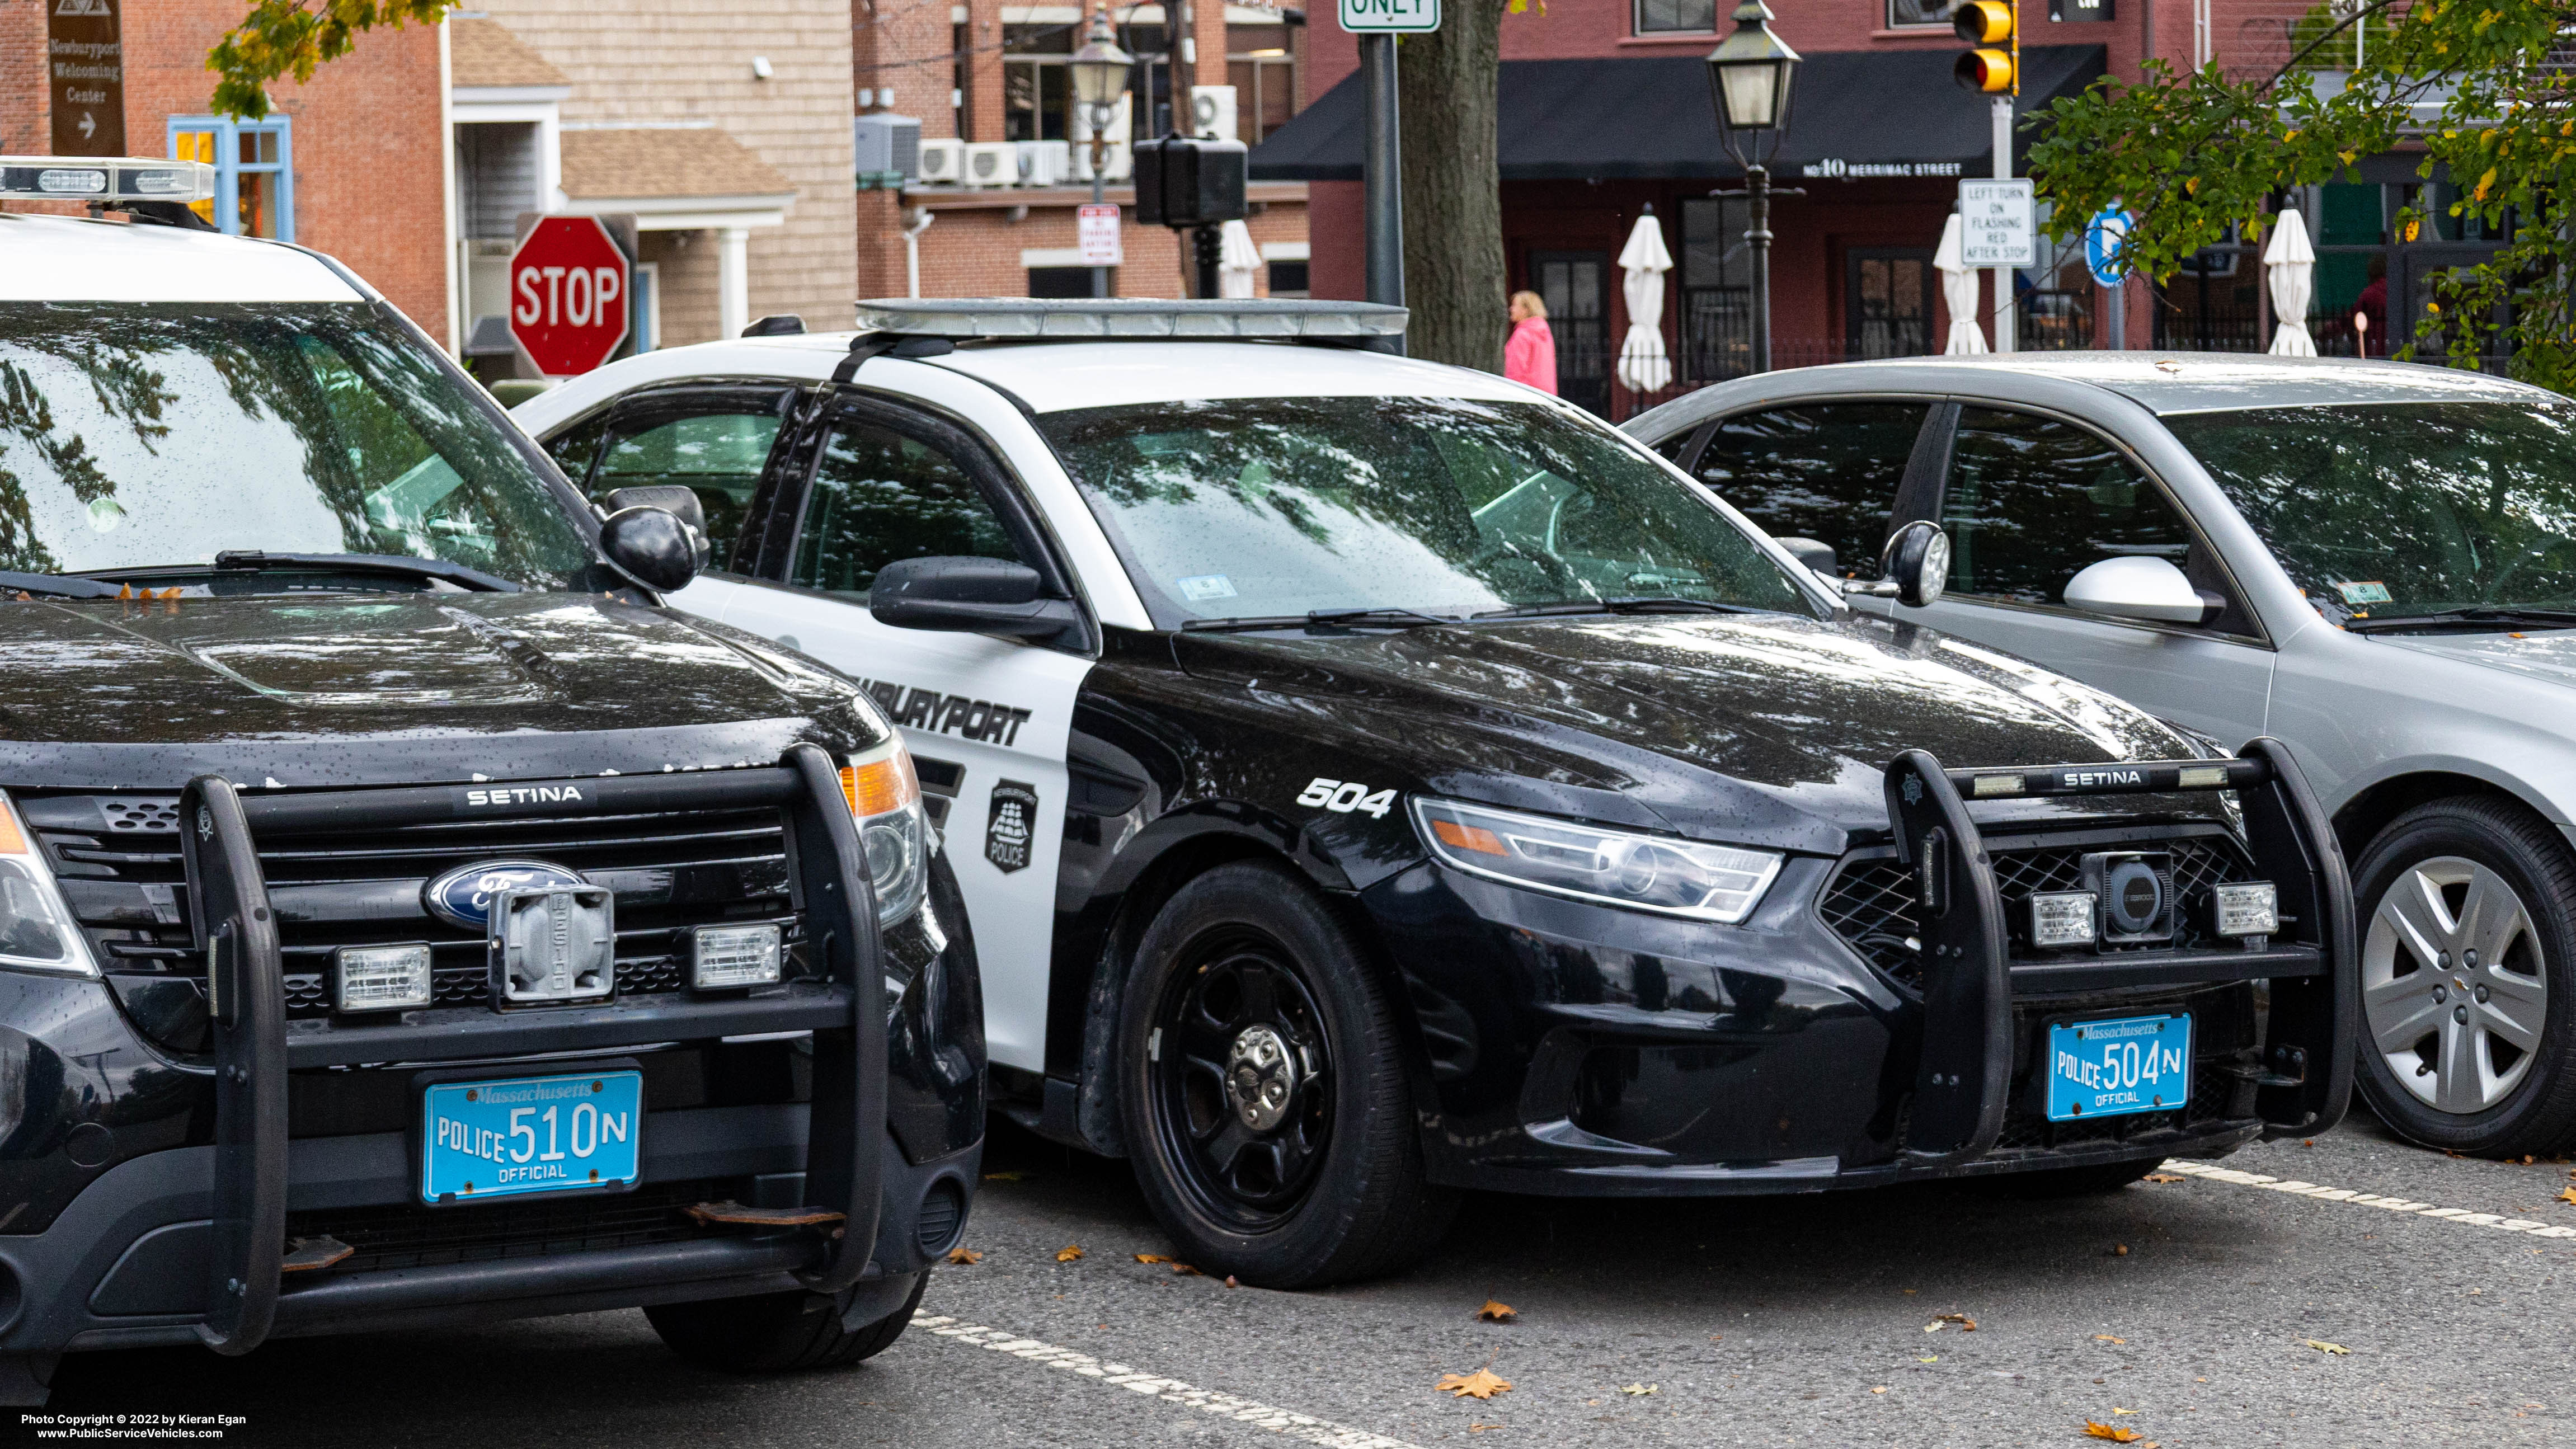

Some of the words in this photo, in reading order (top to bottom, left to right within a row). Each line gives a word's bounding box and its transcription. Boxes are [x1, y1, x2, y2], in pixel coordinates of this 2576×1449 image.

[49, 39, 120, 59] Newburyport
[54, 62, 119, 81] Welcoming
[66, 86, 107, 103] Center
[1848, 164, 1912, 177] MERRIMAC
[1915, 163, 1961, 176] STREET
[1969, 187, 1992, 200] LEFT
[1999, 187, 2024, 198] TURN
[1990, 202, 2004, 214] ON
[1972, 217, 2022, 229] FLASHING
[1987, 232, 2008, 243] RED
[1967, 246, 1998, 258] AFTER
[2004, 246, 2028, 258] STOP
[516, 266, 619, 327] STOP
[2064, 771, 2141, 785] SETINA
[467, 786, 582, 805] SETINA
[1296, 777, 1398, 819] 504
[991, 841, 1024, 866] POLICE
[2082, 1022, 2157, 1040] Massachusetts
[2058, 1050, 2100, 1090] POLICE
[475, 1083, 593, 1105] Massachusetts
[2095, 1092, 2140, 1107] OFFICIAL
[438, 1116, 505, 1164] POLICE
[499, 1164, 567, 1183] OFFICIAL
